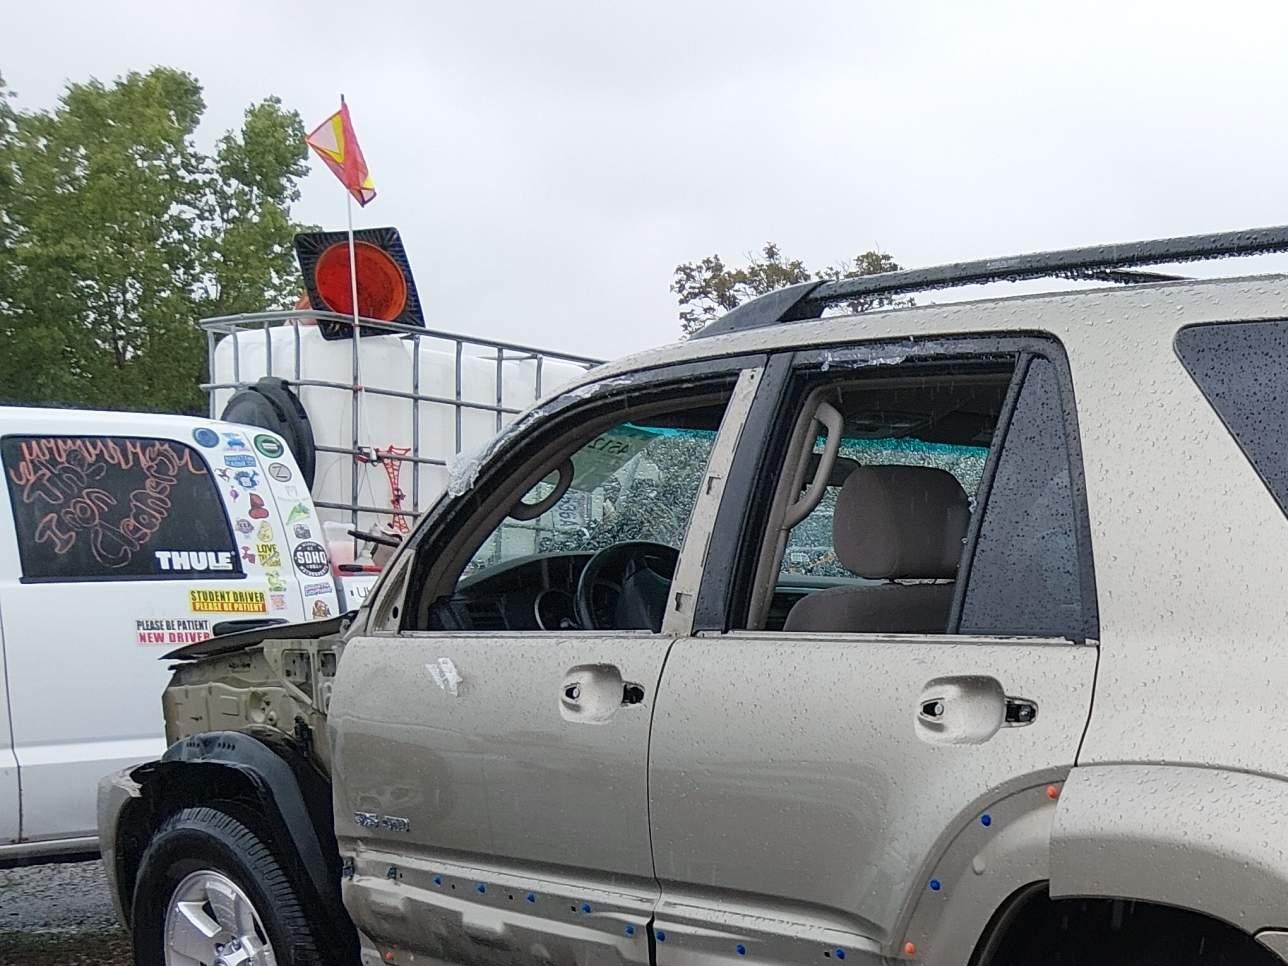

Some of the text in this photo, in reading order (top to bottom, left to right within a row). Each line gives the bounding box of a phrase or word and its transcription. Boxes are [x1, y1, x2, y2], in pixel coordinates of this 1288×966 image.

[35, 488, 117, 554] Iron
[256, 543, 277, 553] LOVE
[155, 551, 234, 571] THULE
[190, 590, 231, 602] STUDENT
[233, 591, 265, 603] DRIVER
[195, 602, 263, 612] PLEASE BE PATIENT
[137, 620, 208, 631] PLEASE BE PATIENT
[139, 632, 210, 643] NEW DRIVER
